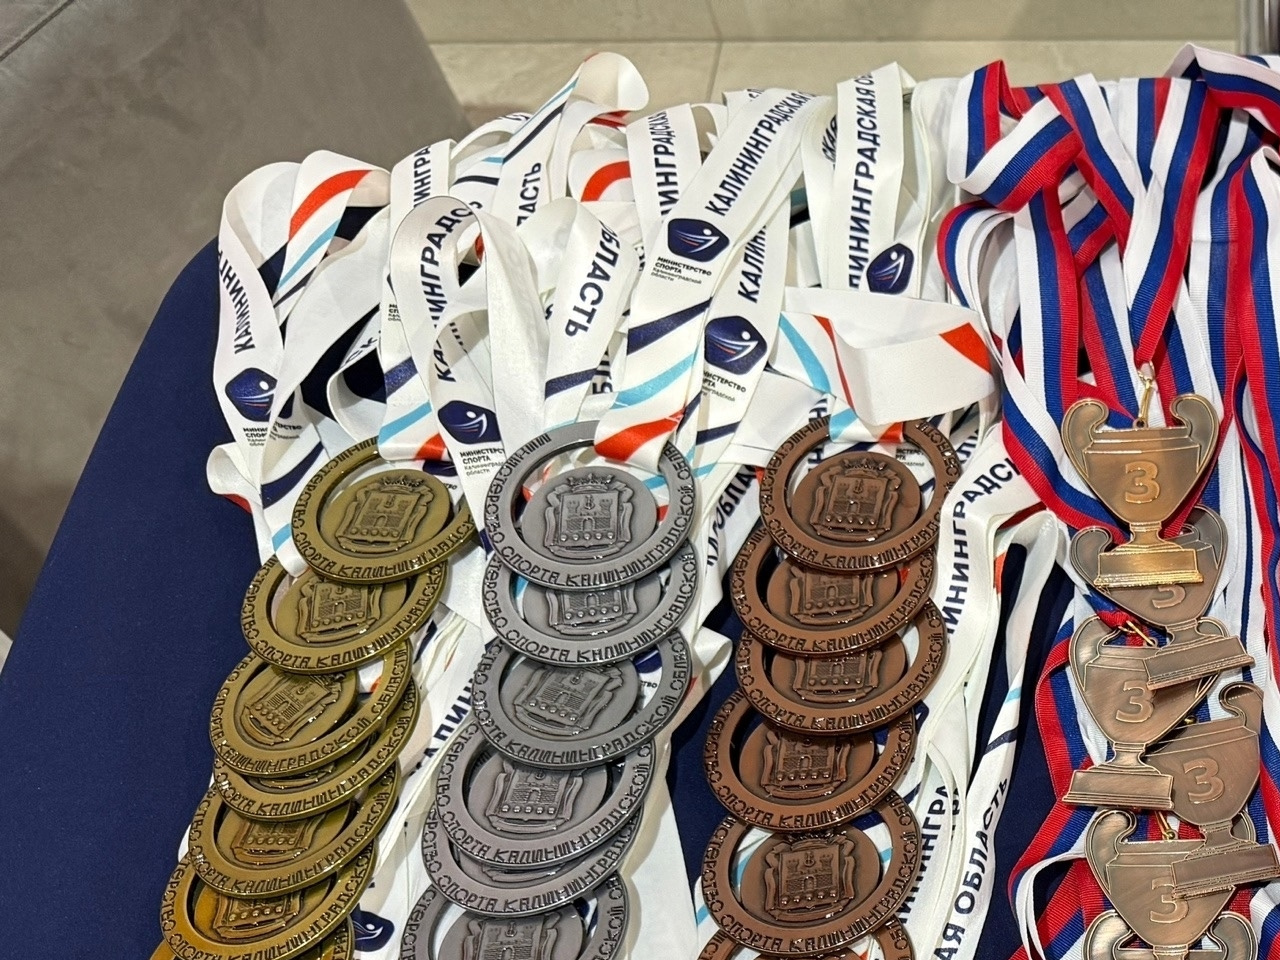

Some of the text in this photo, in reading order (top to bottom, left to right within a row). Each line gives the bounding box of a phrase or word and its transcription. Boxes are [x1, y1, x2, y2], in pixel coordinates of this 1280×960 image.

[655, 262, 682, 275] СПОРТА
[657, 256, 712, 276] МИНИСТЕРСТВО
[1124, 461, 1161, 503] 3
[1115, 681, 1155, 723] 3
[1182, 757, 1225, 804] 3
[955, 779, 1008, 914] ОБЛАСТЬ
